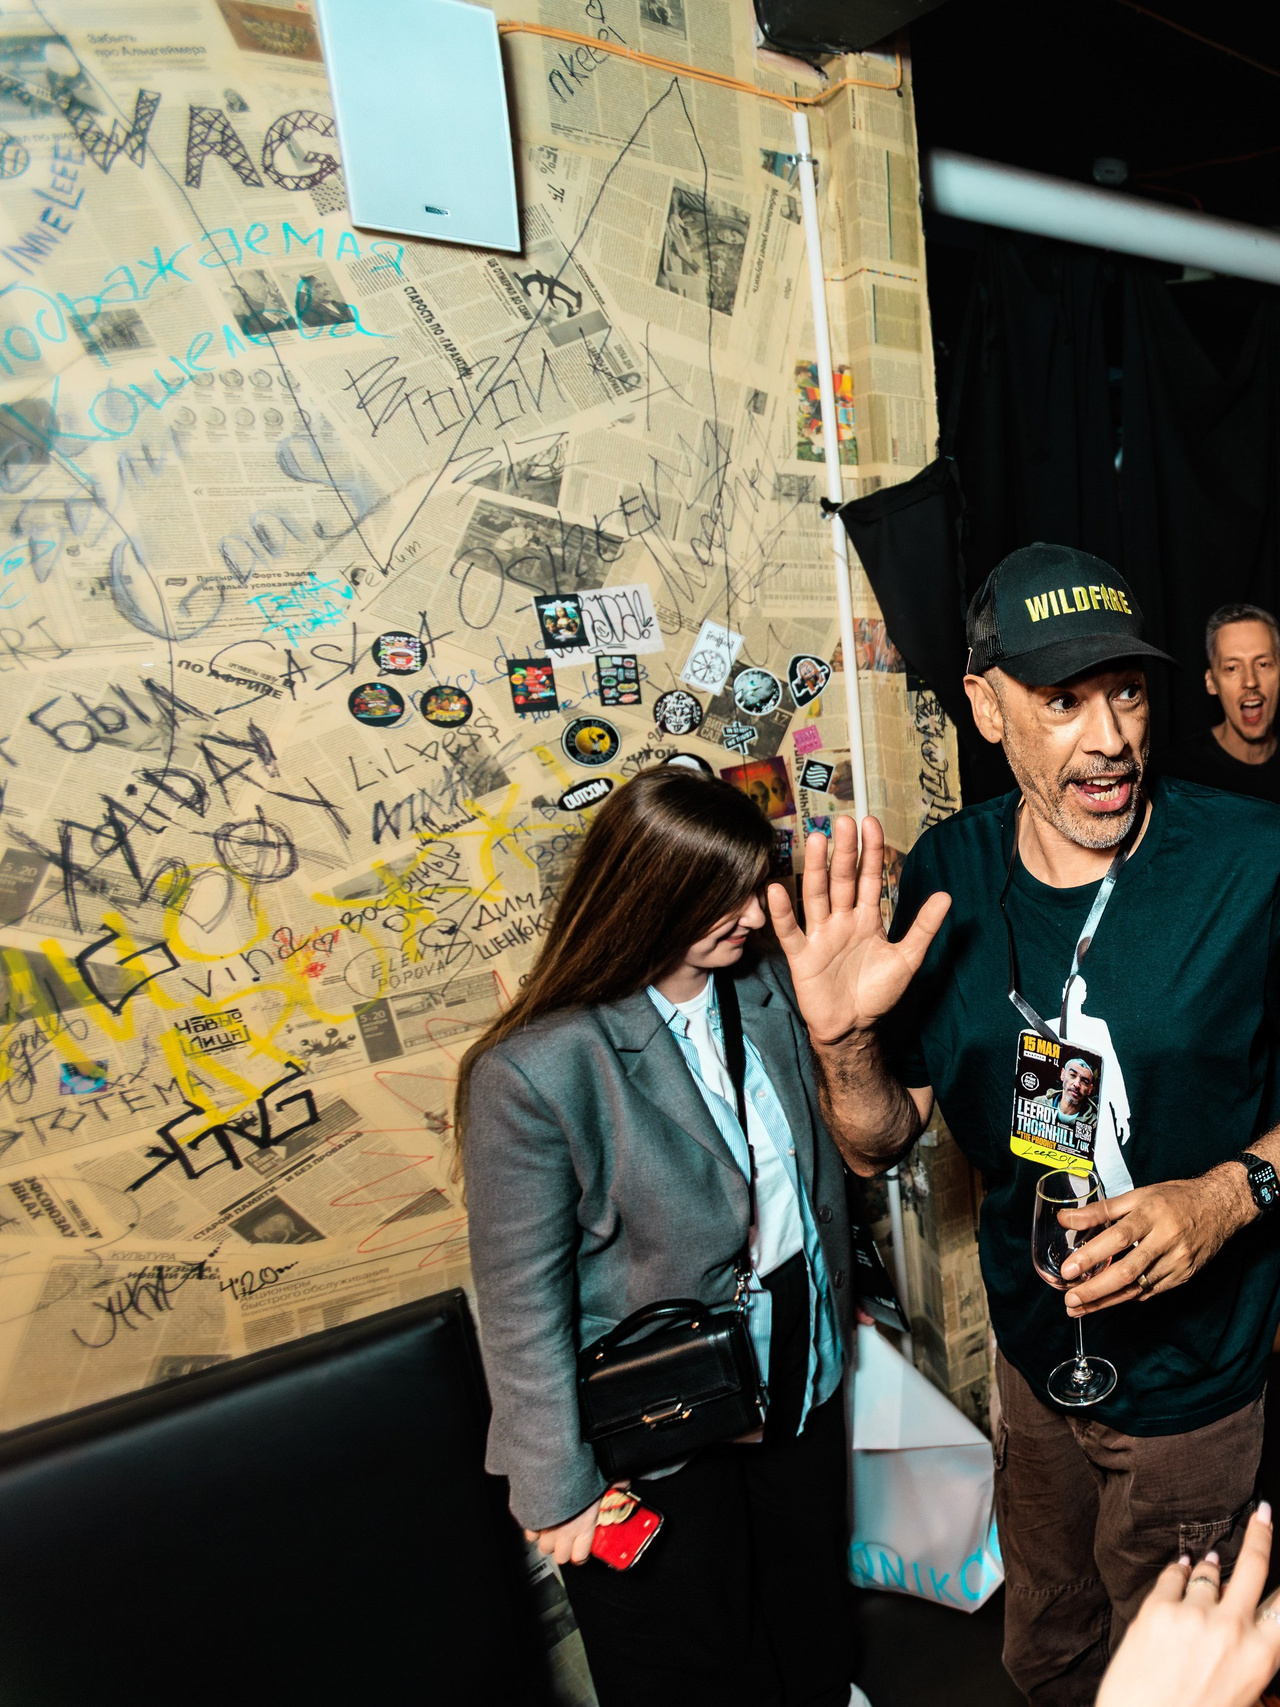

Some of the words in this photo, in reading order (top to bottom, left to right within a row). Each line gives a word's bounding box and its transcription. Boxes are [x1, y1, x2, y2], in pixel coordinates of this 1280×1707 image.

[402, 283, 436, 325] СТАРОСТЬ
[428, 321, 445, 338] ПО
[252, 571, 282, 581] Форте
[176, 659, 205, 674] ПО
[562, 778, 611, 810] OUTCOM
[471, 885, 560, 931] ДИМА
[371, 942, 445, 979] ELENA
[377, 960, 448, 992] POPOVA
[1023, 1035, 1037, 1052] 15
[1037, 1039, 1060, 1060] МАЯ
[1018, 1098, 1058, 1126] LEEROY
[1017, 1114, 1076, 1148] THORNHILL
[1080, 1140, 1090, 1153] UK
[193, 1212, 233, 1240] СТАРОЙ
[294, 1162, 314, 1180] БЕЗ
[312, 1131, 364, 1165] ПРОВАЛОВ
